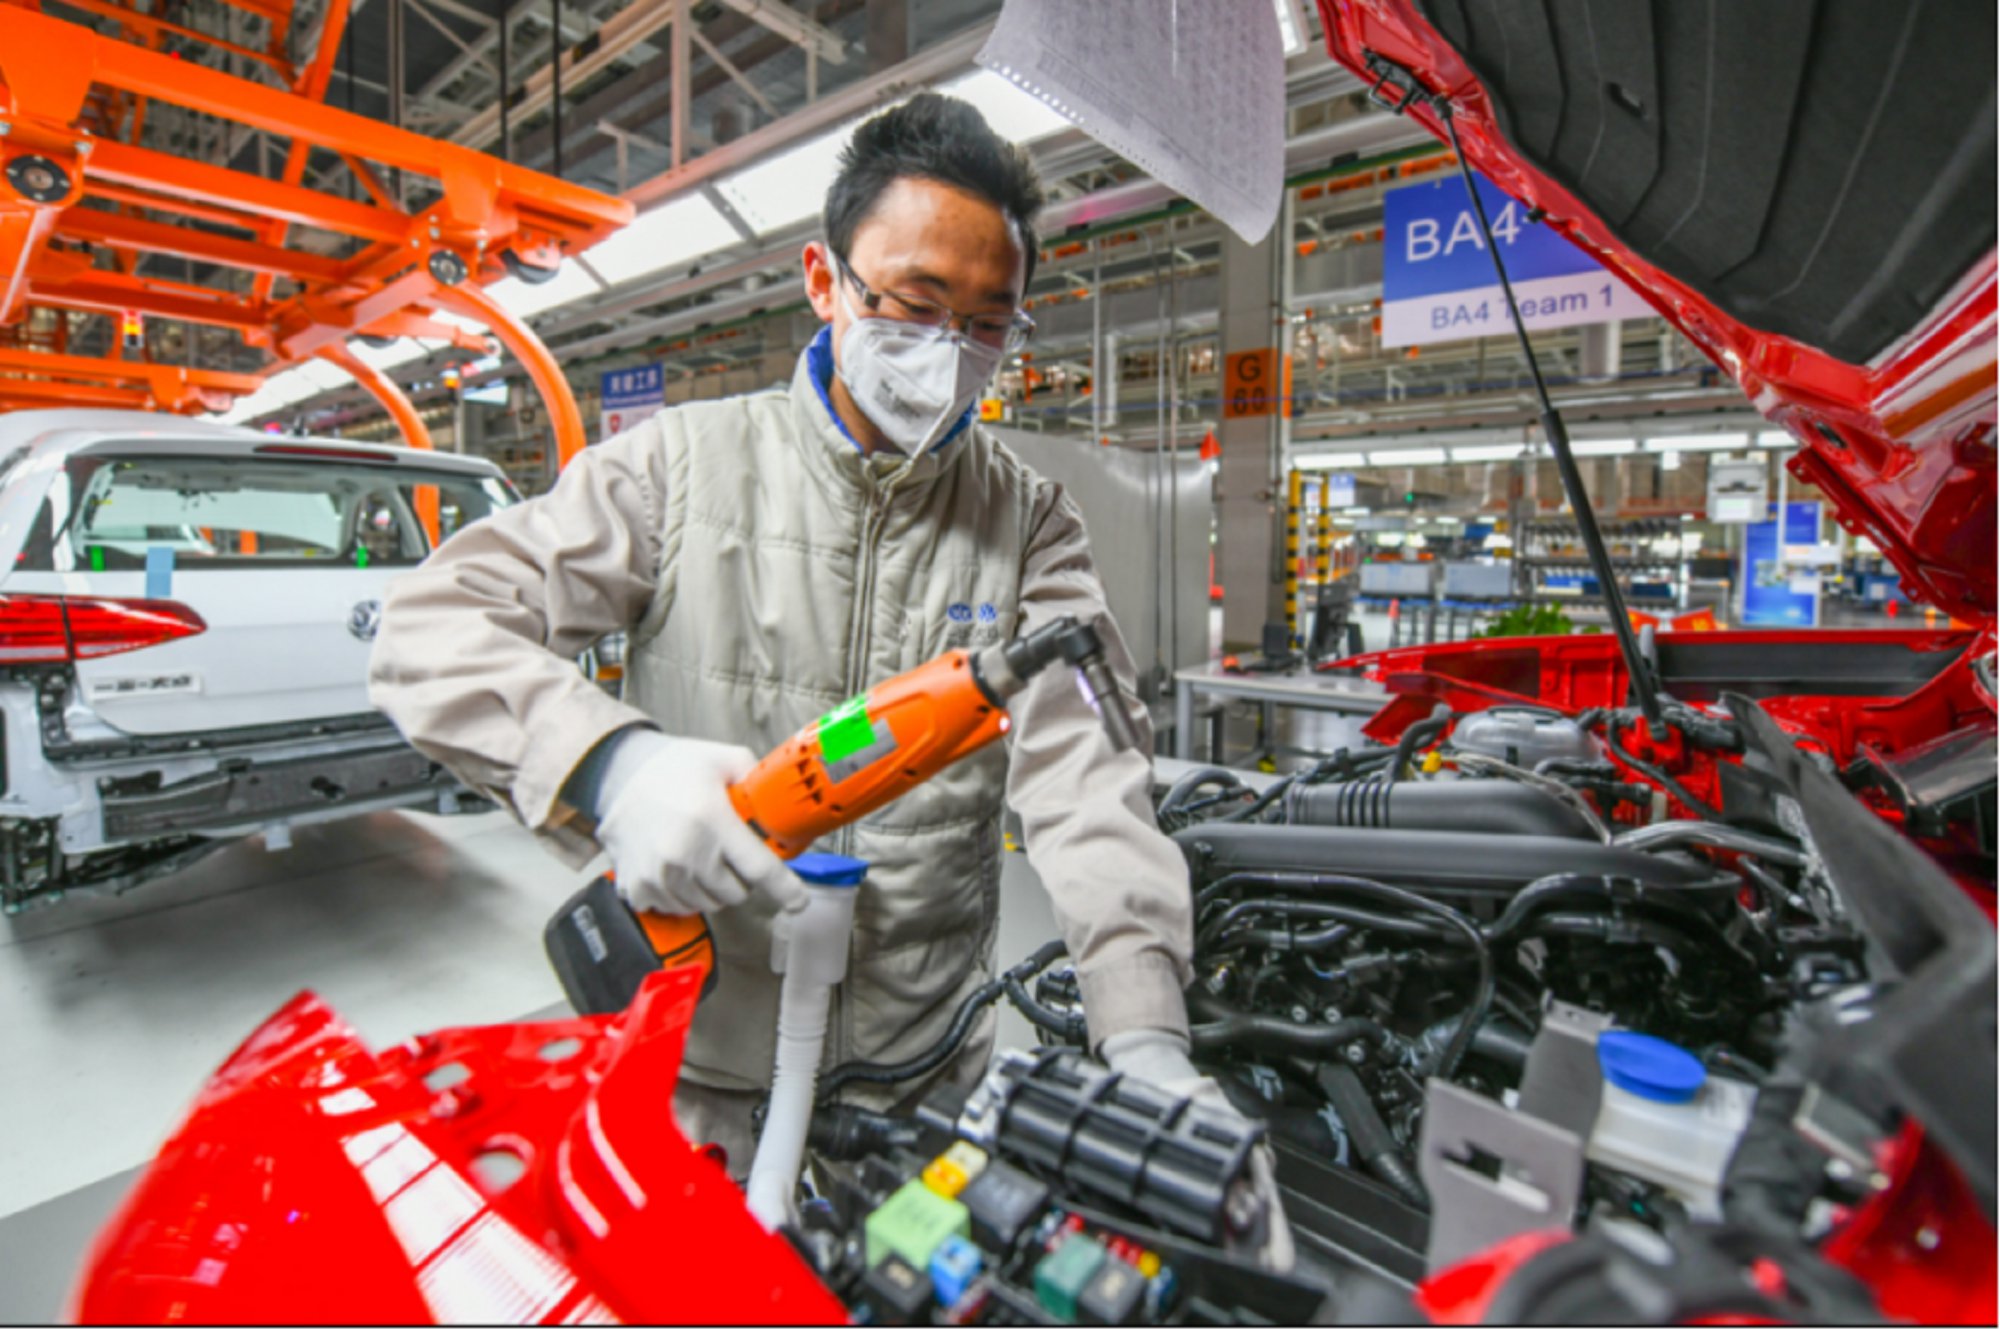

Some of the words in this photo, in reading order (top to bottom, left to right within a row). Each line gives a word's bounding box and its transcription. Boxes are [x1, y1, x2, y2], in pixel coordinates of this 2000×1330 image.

[1406, 201, 1521, 262] BA4
[1431, 300, 1490, 330] BA4
[1500, 291, 1588, 319] Team
[1599, 283, 1612, 307] 1
[1237, 354, 1262, 383] G
